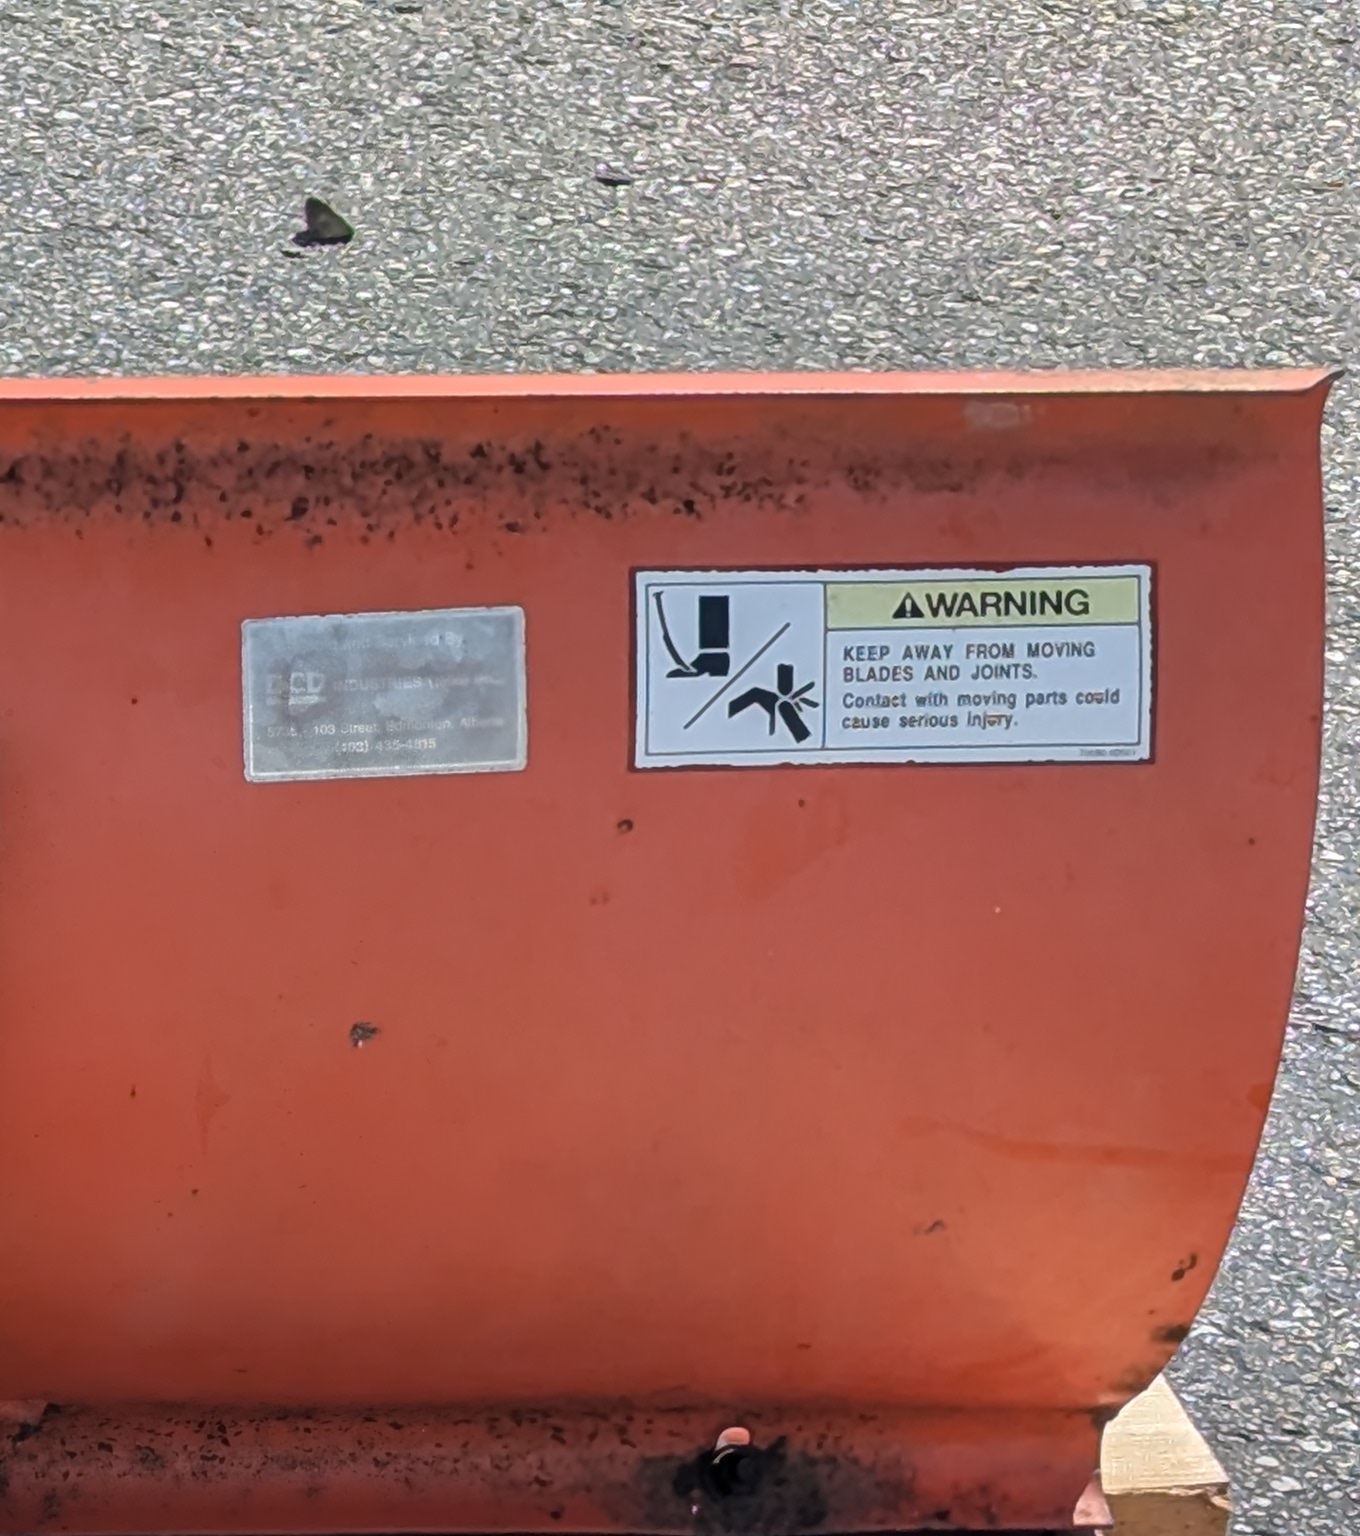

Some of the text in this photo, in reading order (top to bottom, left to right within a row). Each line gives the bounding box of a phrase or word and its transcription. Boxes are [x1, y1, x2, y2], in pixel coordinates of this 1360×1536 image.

[924, 589, 1089, 618] WARNING
[843, 641, 1096, 661] KEEP AWAY FROM MOVING
[843, 663, 1038, 682] BLADES AND JOINTS.
[842, 688, 1120, 709] Contact with moving parts could
[842, 715, 890, 729] cause
[899, 713, 958, 728] serious
